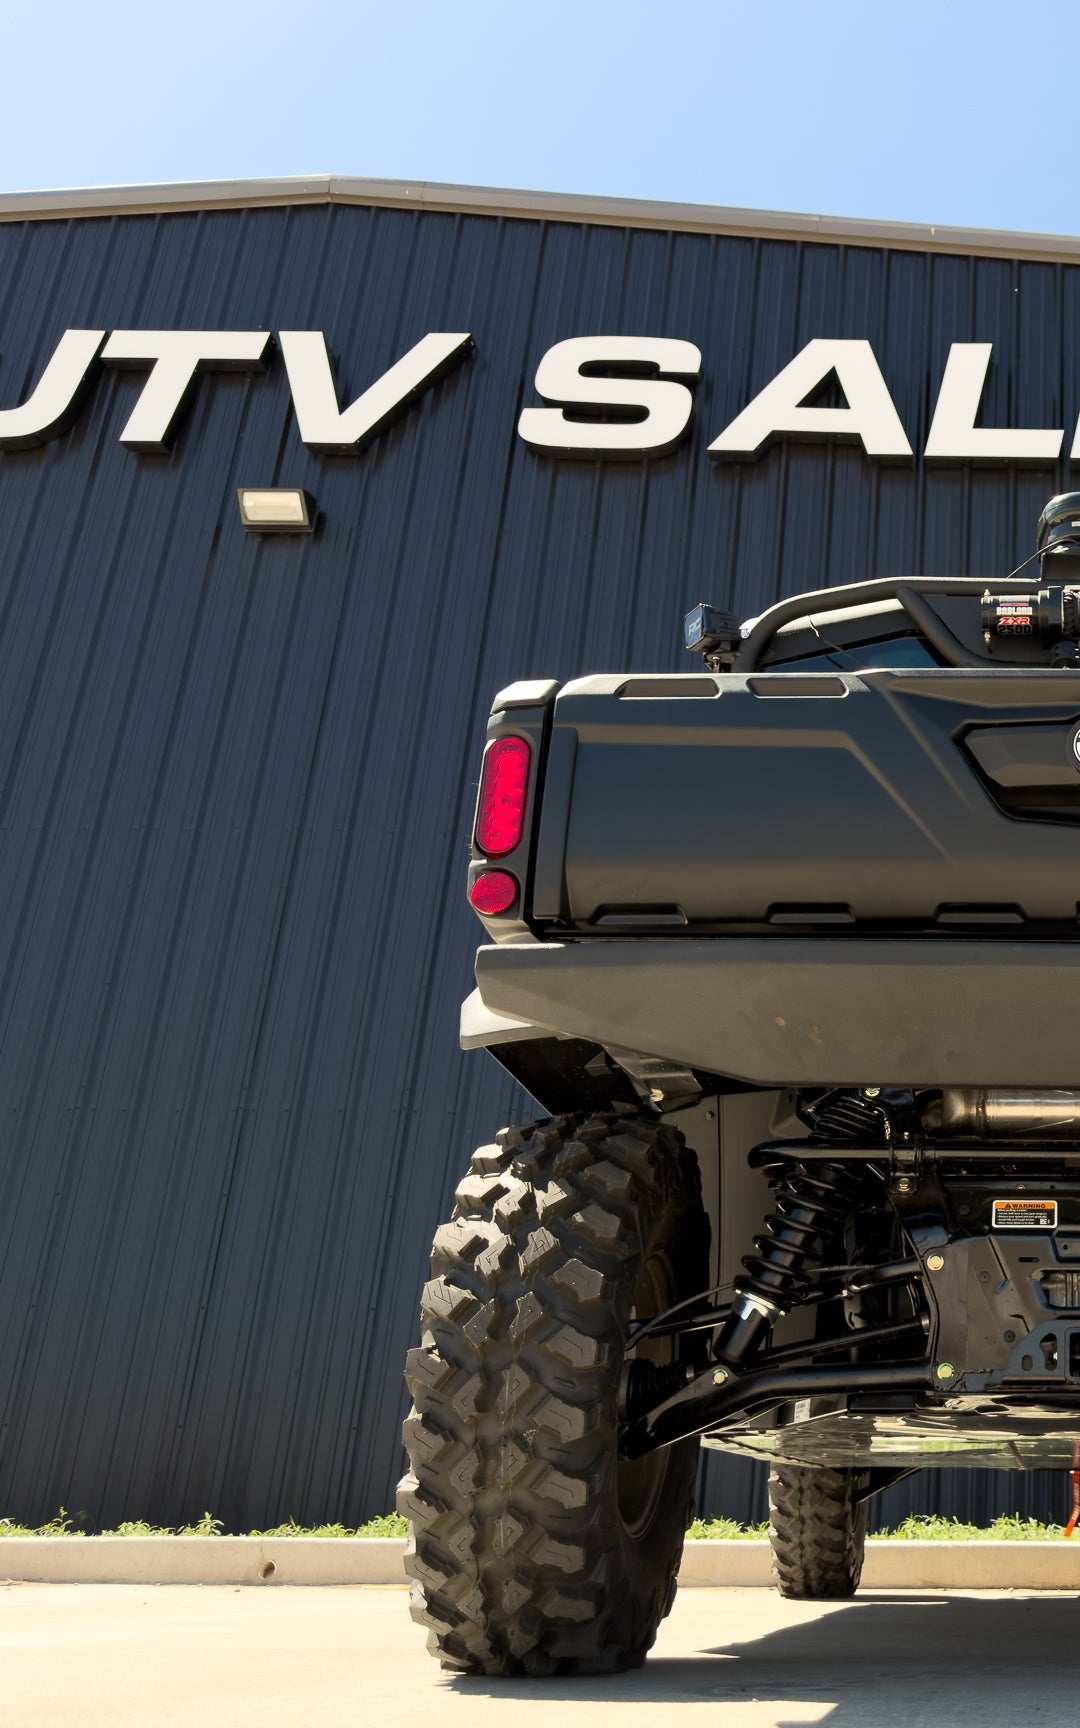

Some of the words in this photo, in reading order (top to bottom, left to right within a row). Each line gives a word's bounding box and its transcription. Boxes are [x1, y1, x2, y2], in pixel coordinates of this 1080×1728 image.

[999, 616, 1031, 625] ZXR
[688, 618, 702, 636] RC
[997, 624, 1032, 634] 2500
